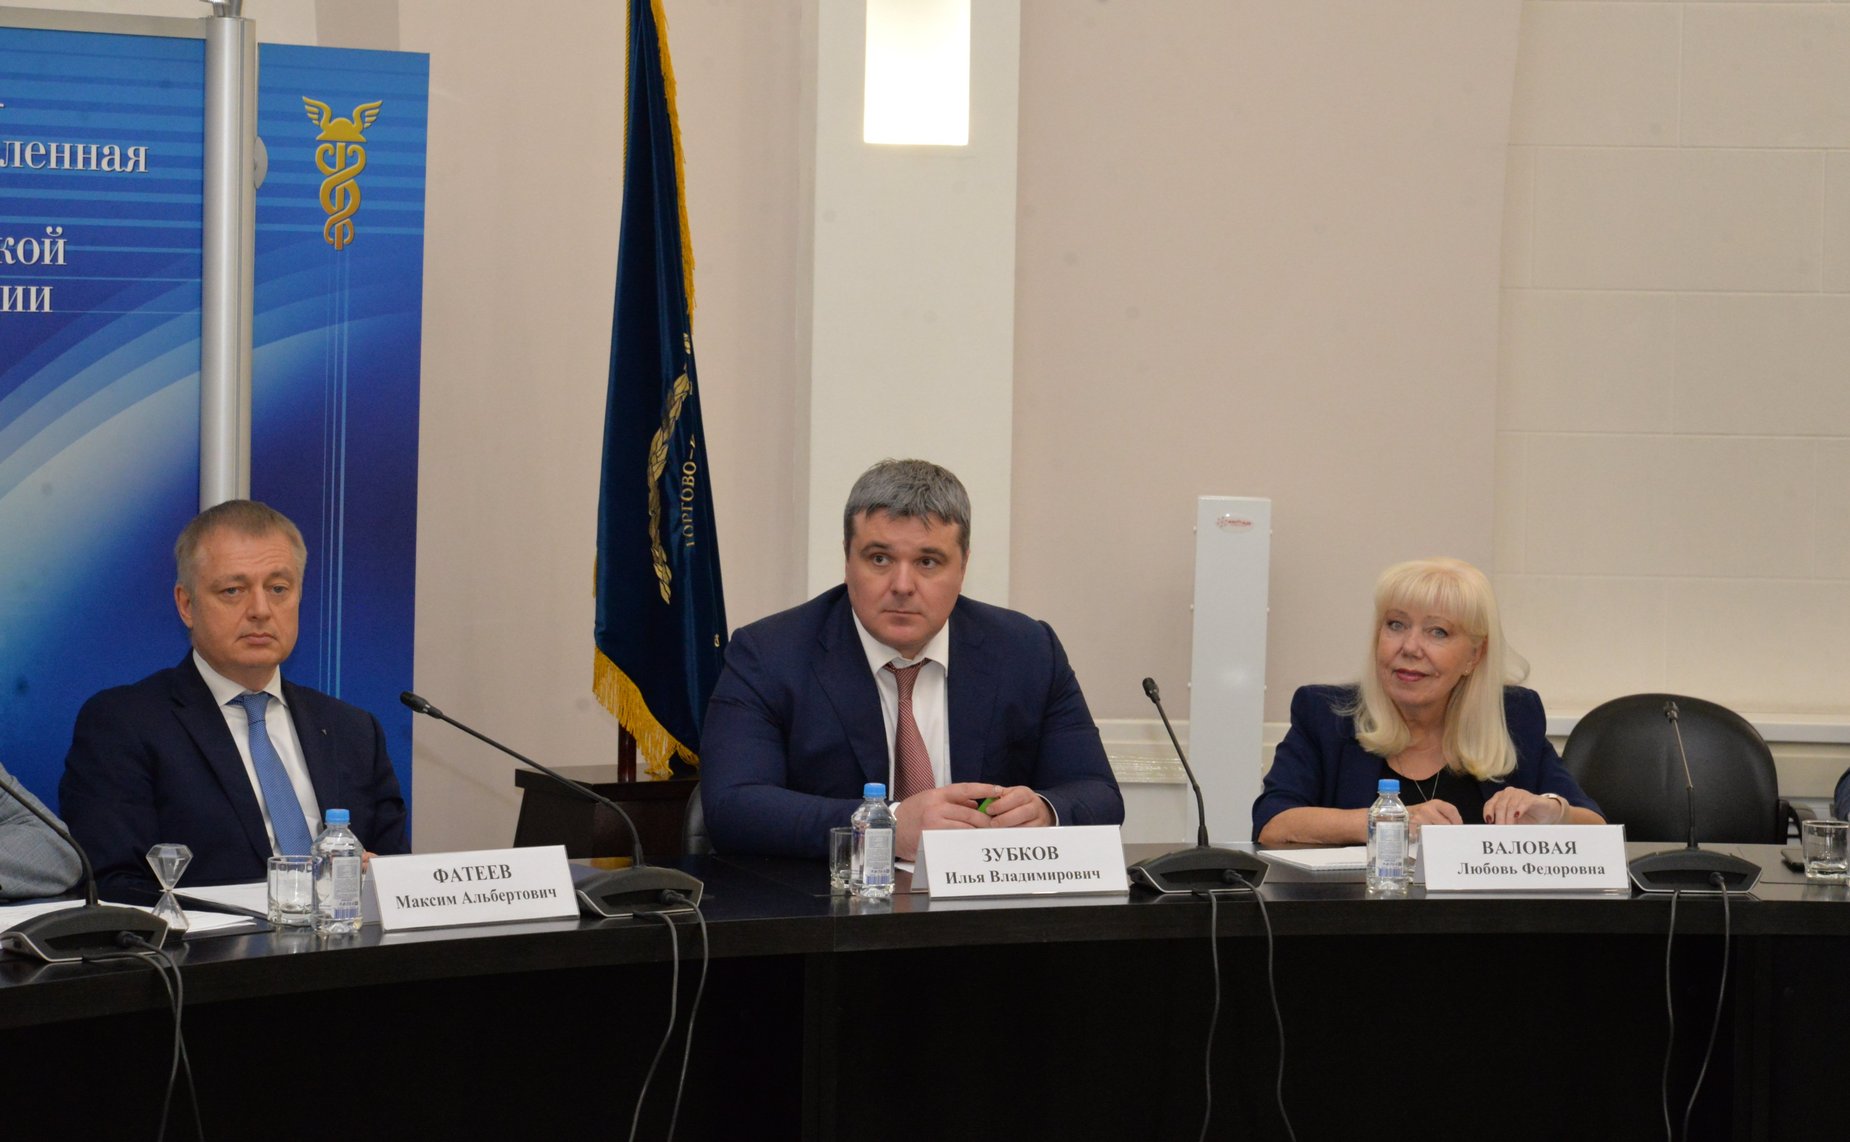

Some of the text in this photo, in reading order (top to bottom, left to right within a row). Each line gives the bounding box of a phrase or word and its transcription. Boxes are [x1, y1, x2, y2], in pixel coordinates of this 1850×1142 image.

[0, 140, 149, 172] ленная
[982, 845, 1059, 862] ЗУБКОВ
[1482, 840, 1577, 855] ВАЛОВАЯ
[433, 863, 512, 883] ФАТЕЕВ
[945, 868, 1101, 885] Илья Владимирович
[1457, 862, 1606, 876] Любовь Федоровна
[395, 887, 557, 909] Максим Альбертович
